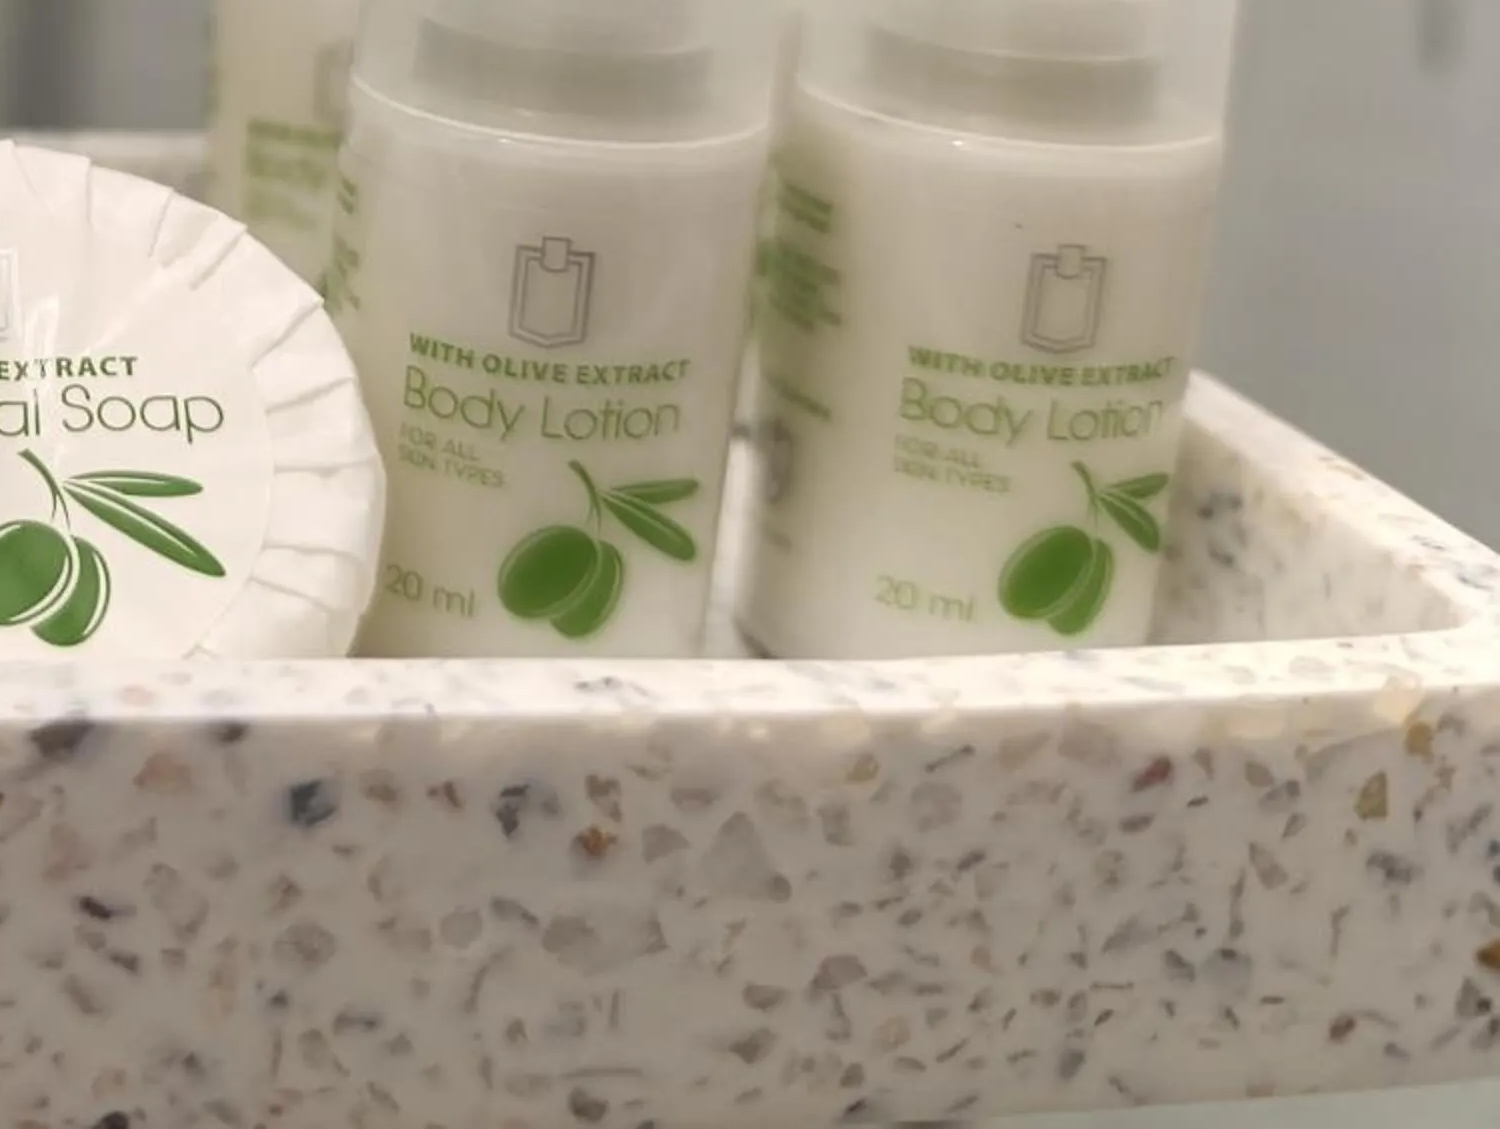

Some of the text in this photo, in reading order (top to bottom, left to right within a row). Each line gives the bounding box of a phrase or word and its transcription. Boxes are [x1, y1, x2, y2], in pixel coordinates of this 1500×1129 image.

[410, 331, 692, 385] WITH OLIVE EXTRACT
[908, 345, 980, 377] WITH
[989, 361, 1074, 386] OLIVE
[61, 383, 224, 444] Soap
[403, 365, 681, 445] Body Lotion
[900, 377, 1033, 447] Body
[384, 564, 475, 617] 20 ml
[874, 574, 975, 622] 20 ml
